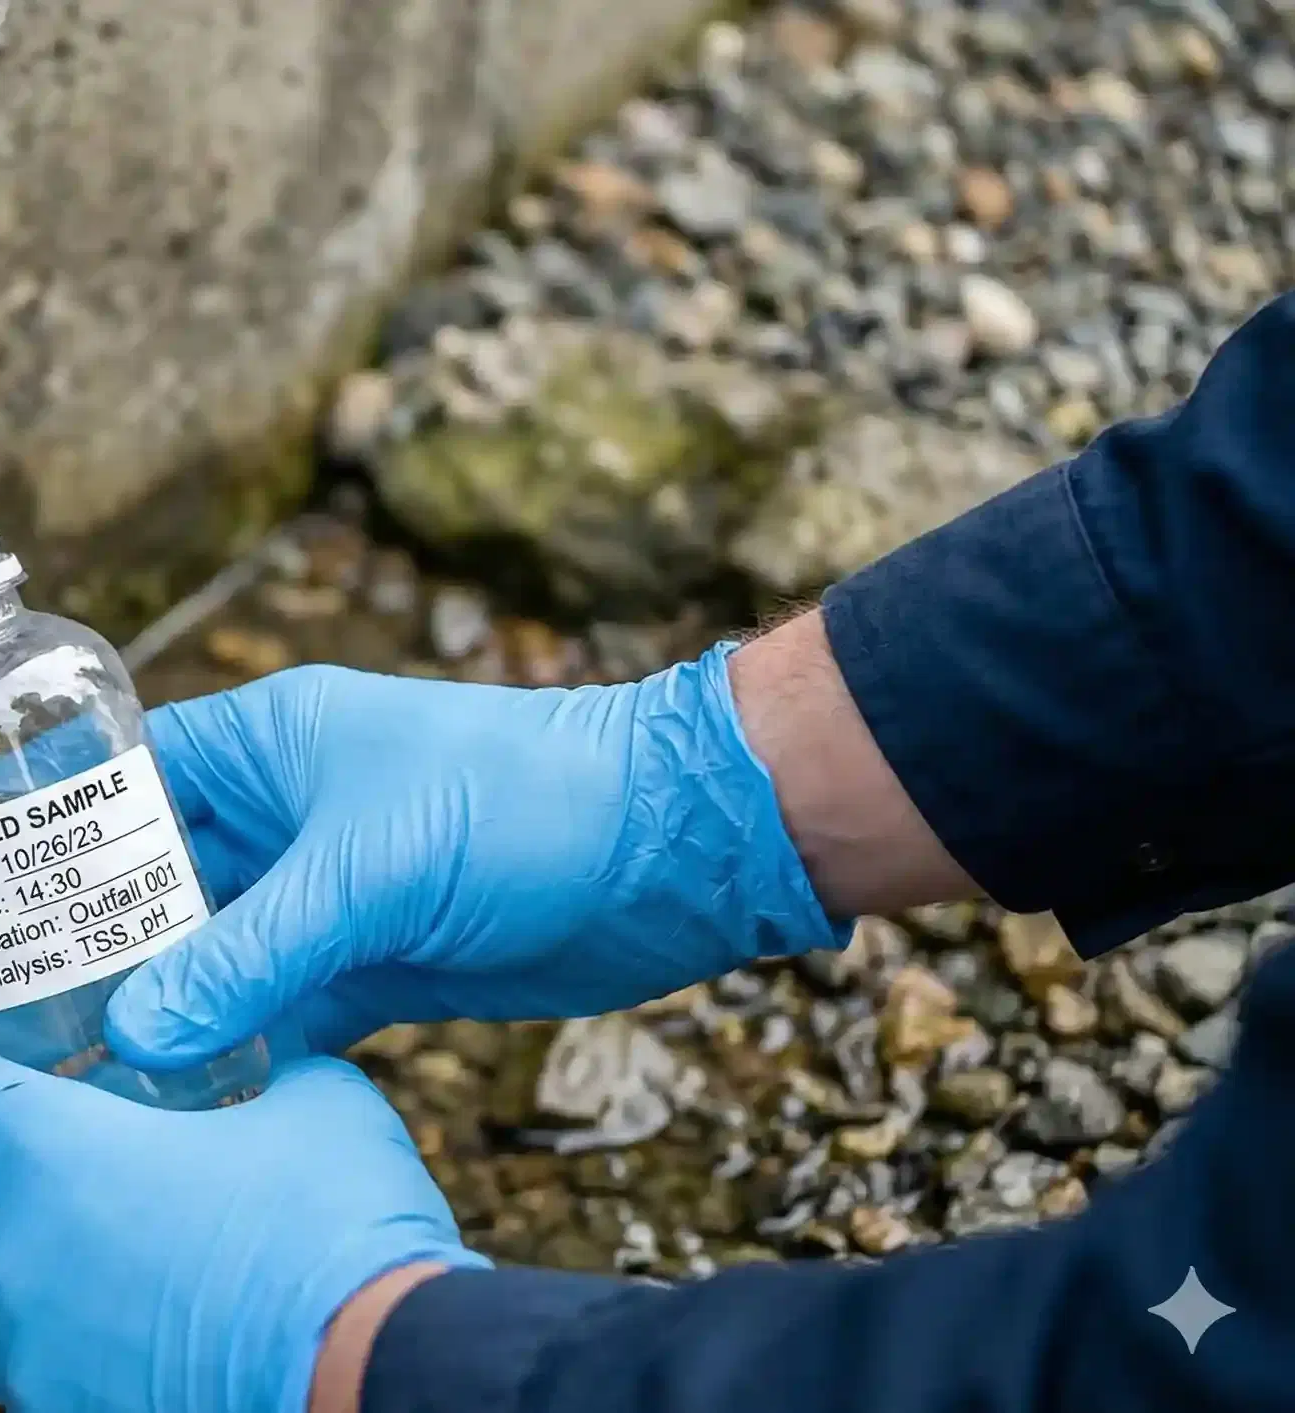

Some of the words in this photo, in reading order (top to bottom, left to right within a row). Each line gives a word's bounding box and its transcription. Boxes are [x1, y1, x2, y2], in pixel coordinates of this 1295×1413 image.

[26, 771, 128, 828] SAMPLE
[1, 820, 103, 874] 10/26/23
[16, 867, 81, 907] 14:30
[69, 879, 142, 924] Outfall
[146, 862, 177, 892] 001
[75, 924, 136, 958] TSS,
[140, 903, 169, 939] pH
